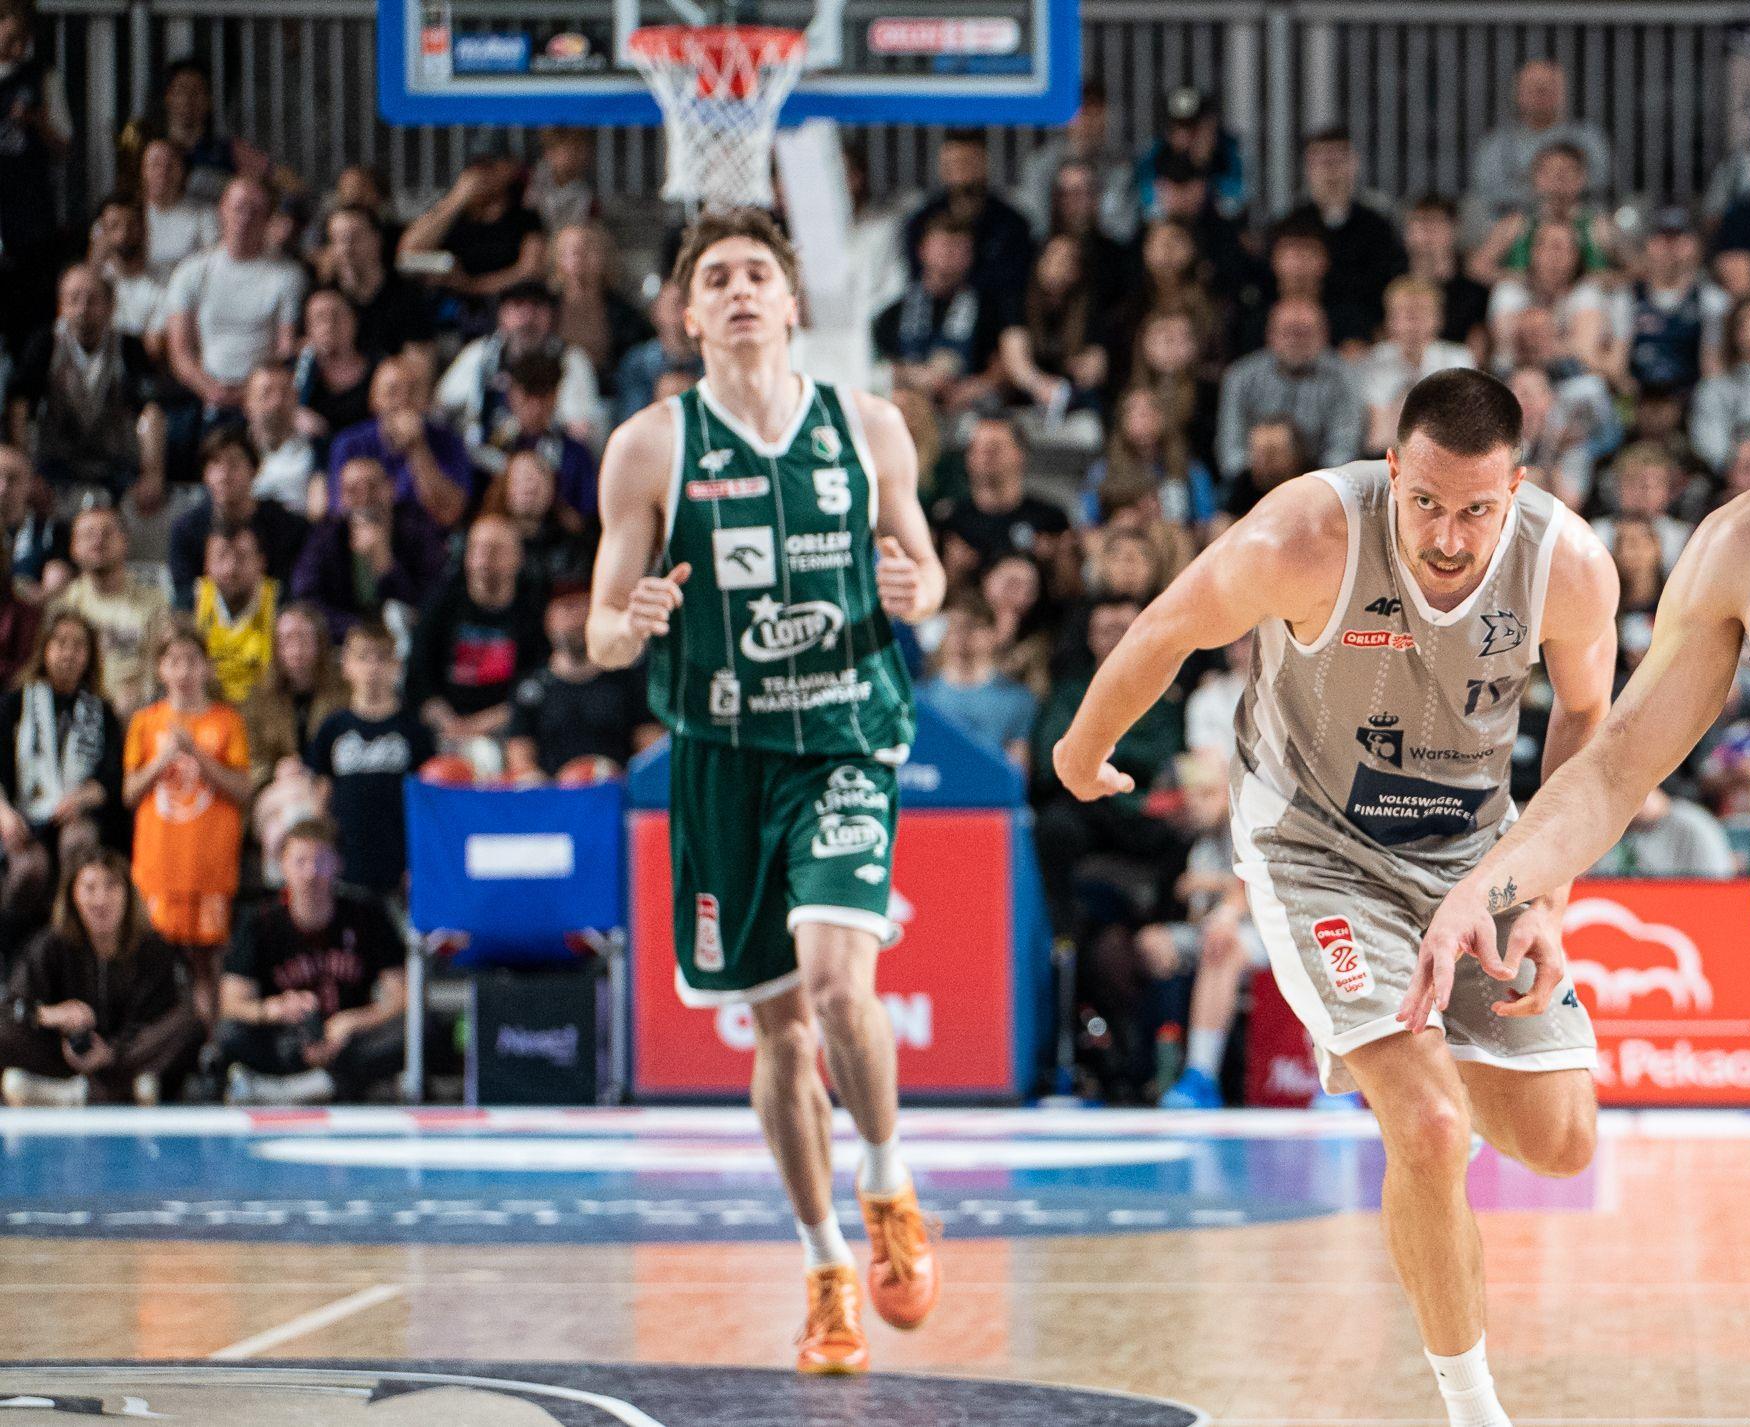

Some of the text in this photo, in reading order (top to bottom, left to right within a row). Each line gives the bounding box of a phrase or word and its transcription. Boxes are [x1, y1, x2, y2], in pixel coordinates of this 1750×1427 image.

[812, 467, 851, 515] 5
[1346, 632, 1386, 645] ORLEN
[1378, 794, 1463, 807] VOLKSWAGEN
[1354, 803, 1420, 818] FINANCIAL
